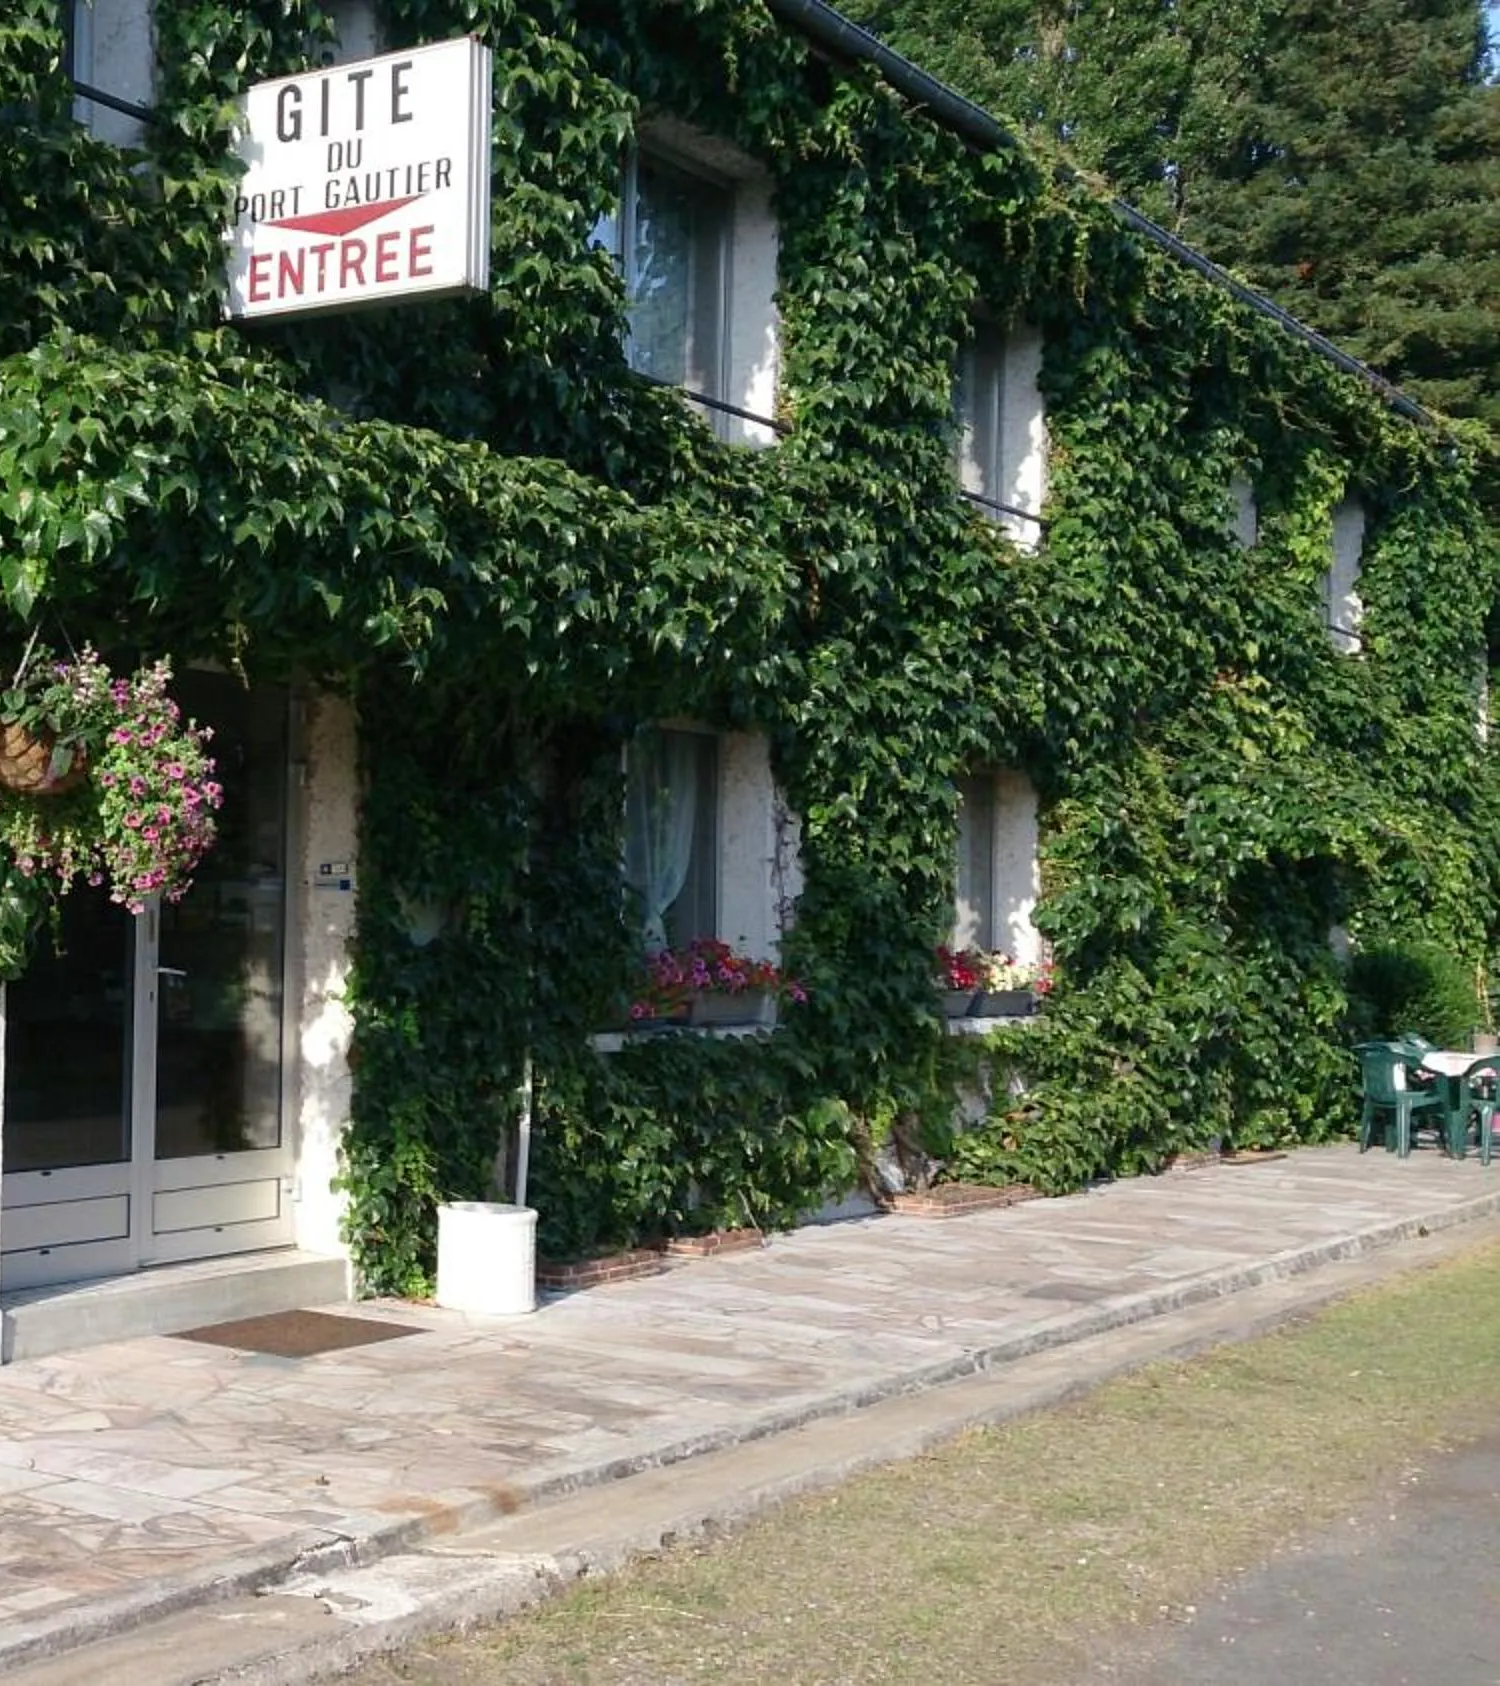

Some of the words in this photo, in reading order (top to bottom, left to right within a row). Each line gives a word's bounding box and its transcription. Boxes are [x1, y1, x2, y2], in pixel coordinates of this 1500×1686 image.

[276, 60, 413, 143] GITE
[235, 185, 303, 227] PORT
[324, 157, 451, 209] GAUTIER
[327, 138, 362, 173] DU
[248, 224, 435, 303] ENTREE
